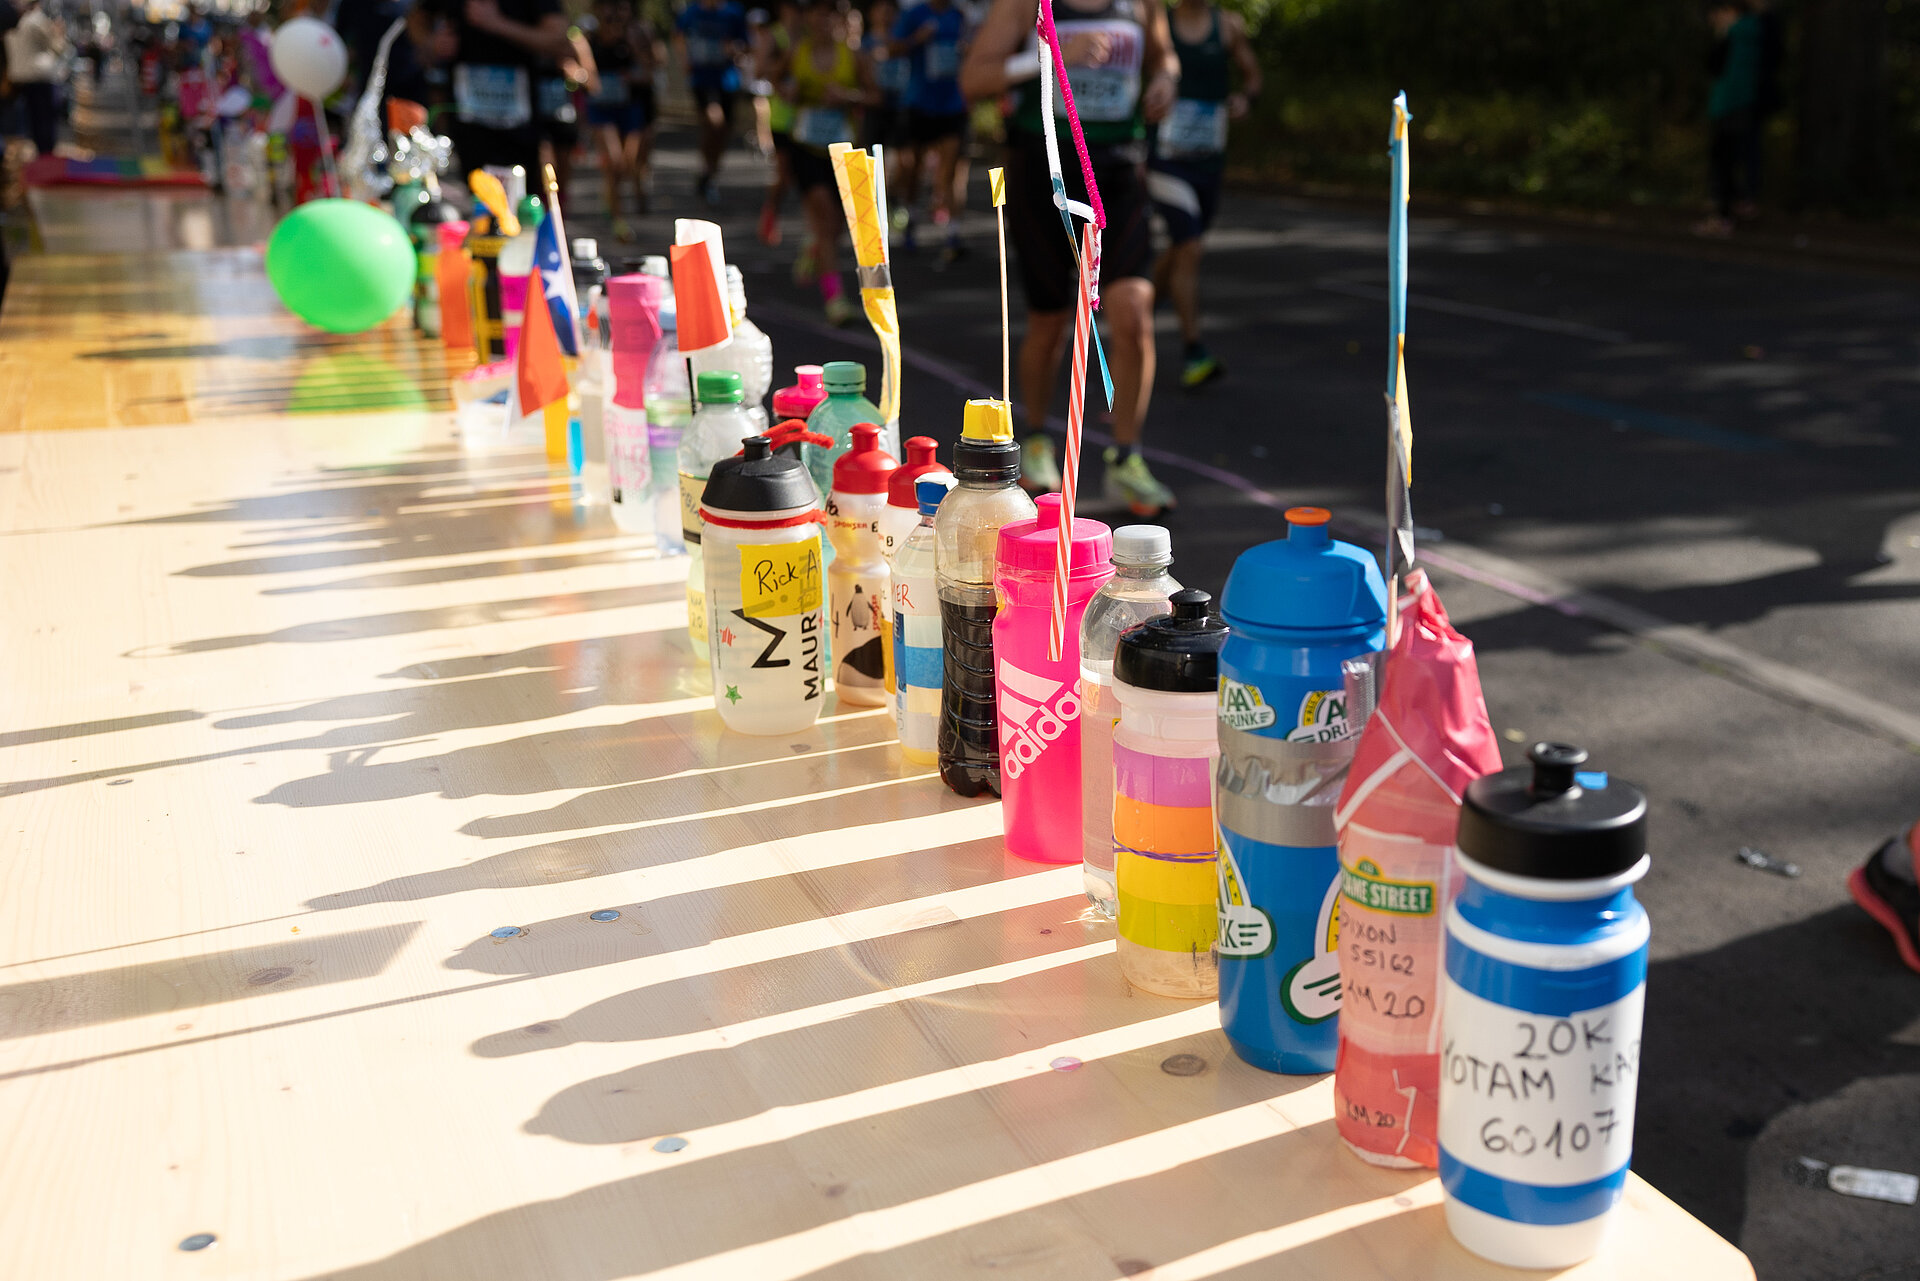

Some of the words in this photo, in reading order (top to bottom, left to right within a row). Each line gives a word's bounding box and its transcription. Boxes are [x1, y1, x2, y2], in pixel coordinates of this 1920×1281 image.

[754, 559, 799, 595] Rick
[807, 548, 820, 580] A
[894, 582, 915, 609] ER
[1226, 687, 1251, 712] AA
[1318, 722, 1348, 744] DRI
[1369, 882, 1430, 912] STREET
[1383, 991, 1425, 1018] 20
[1514, 1018, 1613, 1060] 20K
[1375, 1109, 1396, 1129] 20
[1480, 1108, 1618, 1160] 60107
